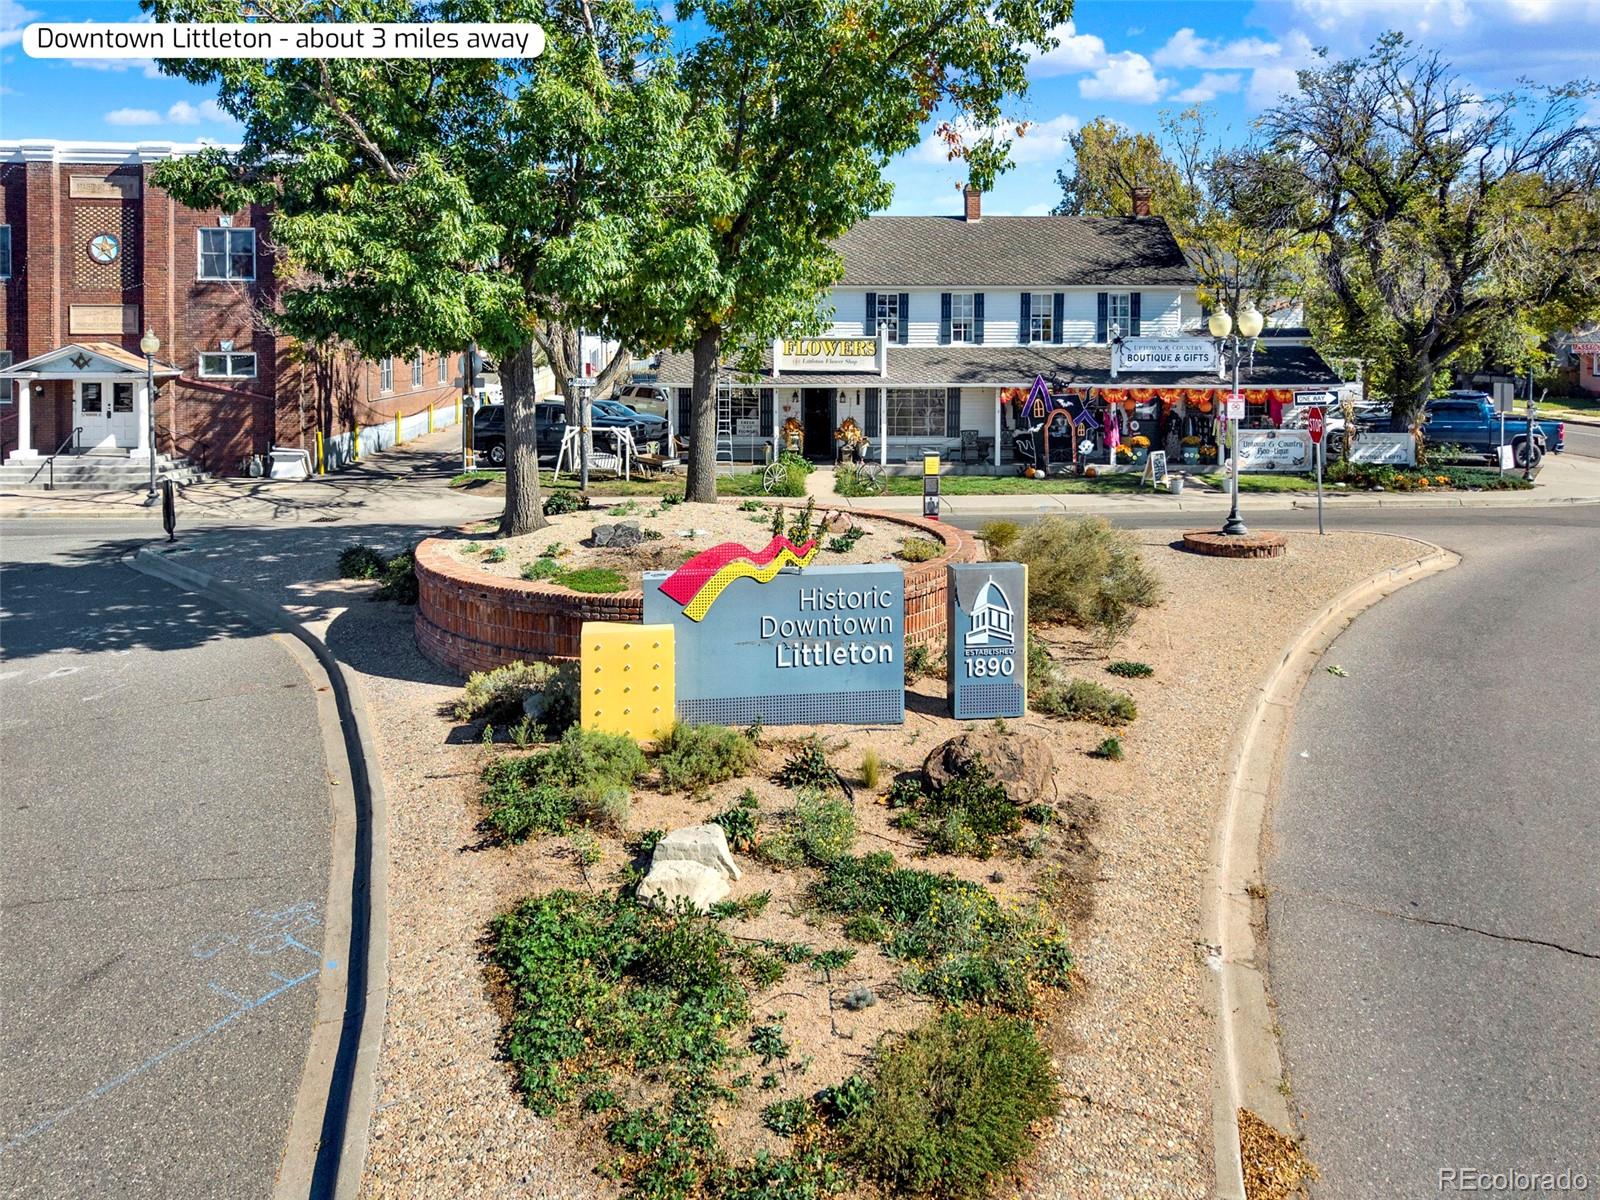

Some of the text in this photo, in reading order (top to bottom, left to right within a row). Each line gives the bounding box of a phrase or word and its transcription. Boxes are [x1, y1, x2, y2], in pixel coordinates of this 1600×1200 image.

[783, 340, 877, 356] FLOWERS
[1127, 353, 1209, 362] BOUTIQUE & GIFTS
[1309, 418, 1322, 432] STOP
[800, 585, 893, 611] Historic
[761, 613, 893, 639] Downtown
[776, 641, 893, 668] Littleton
[964, 648, 1015, 657] ESTABLISHED
[964, 657, 1015, 678] 1890
